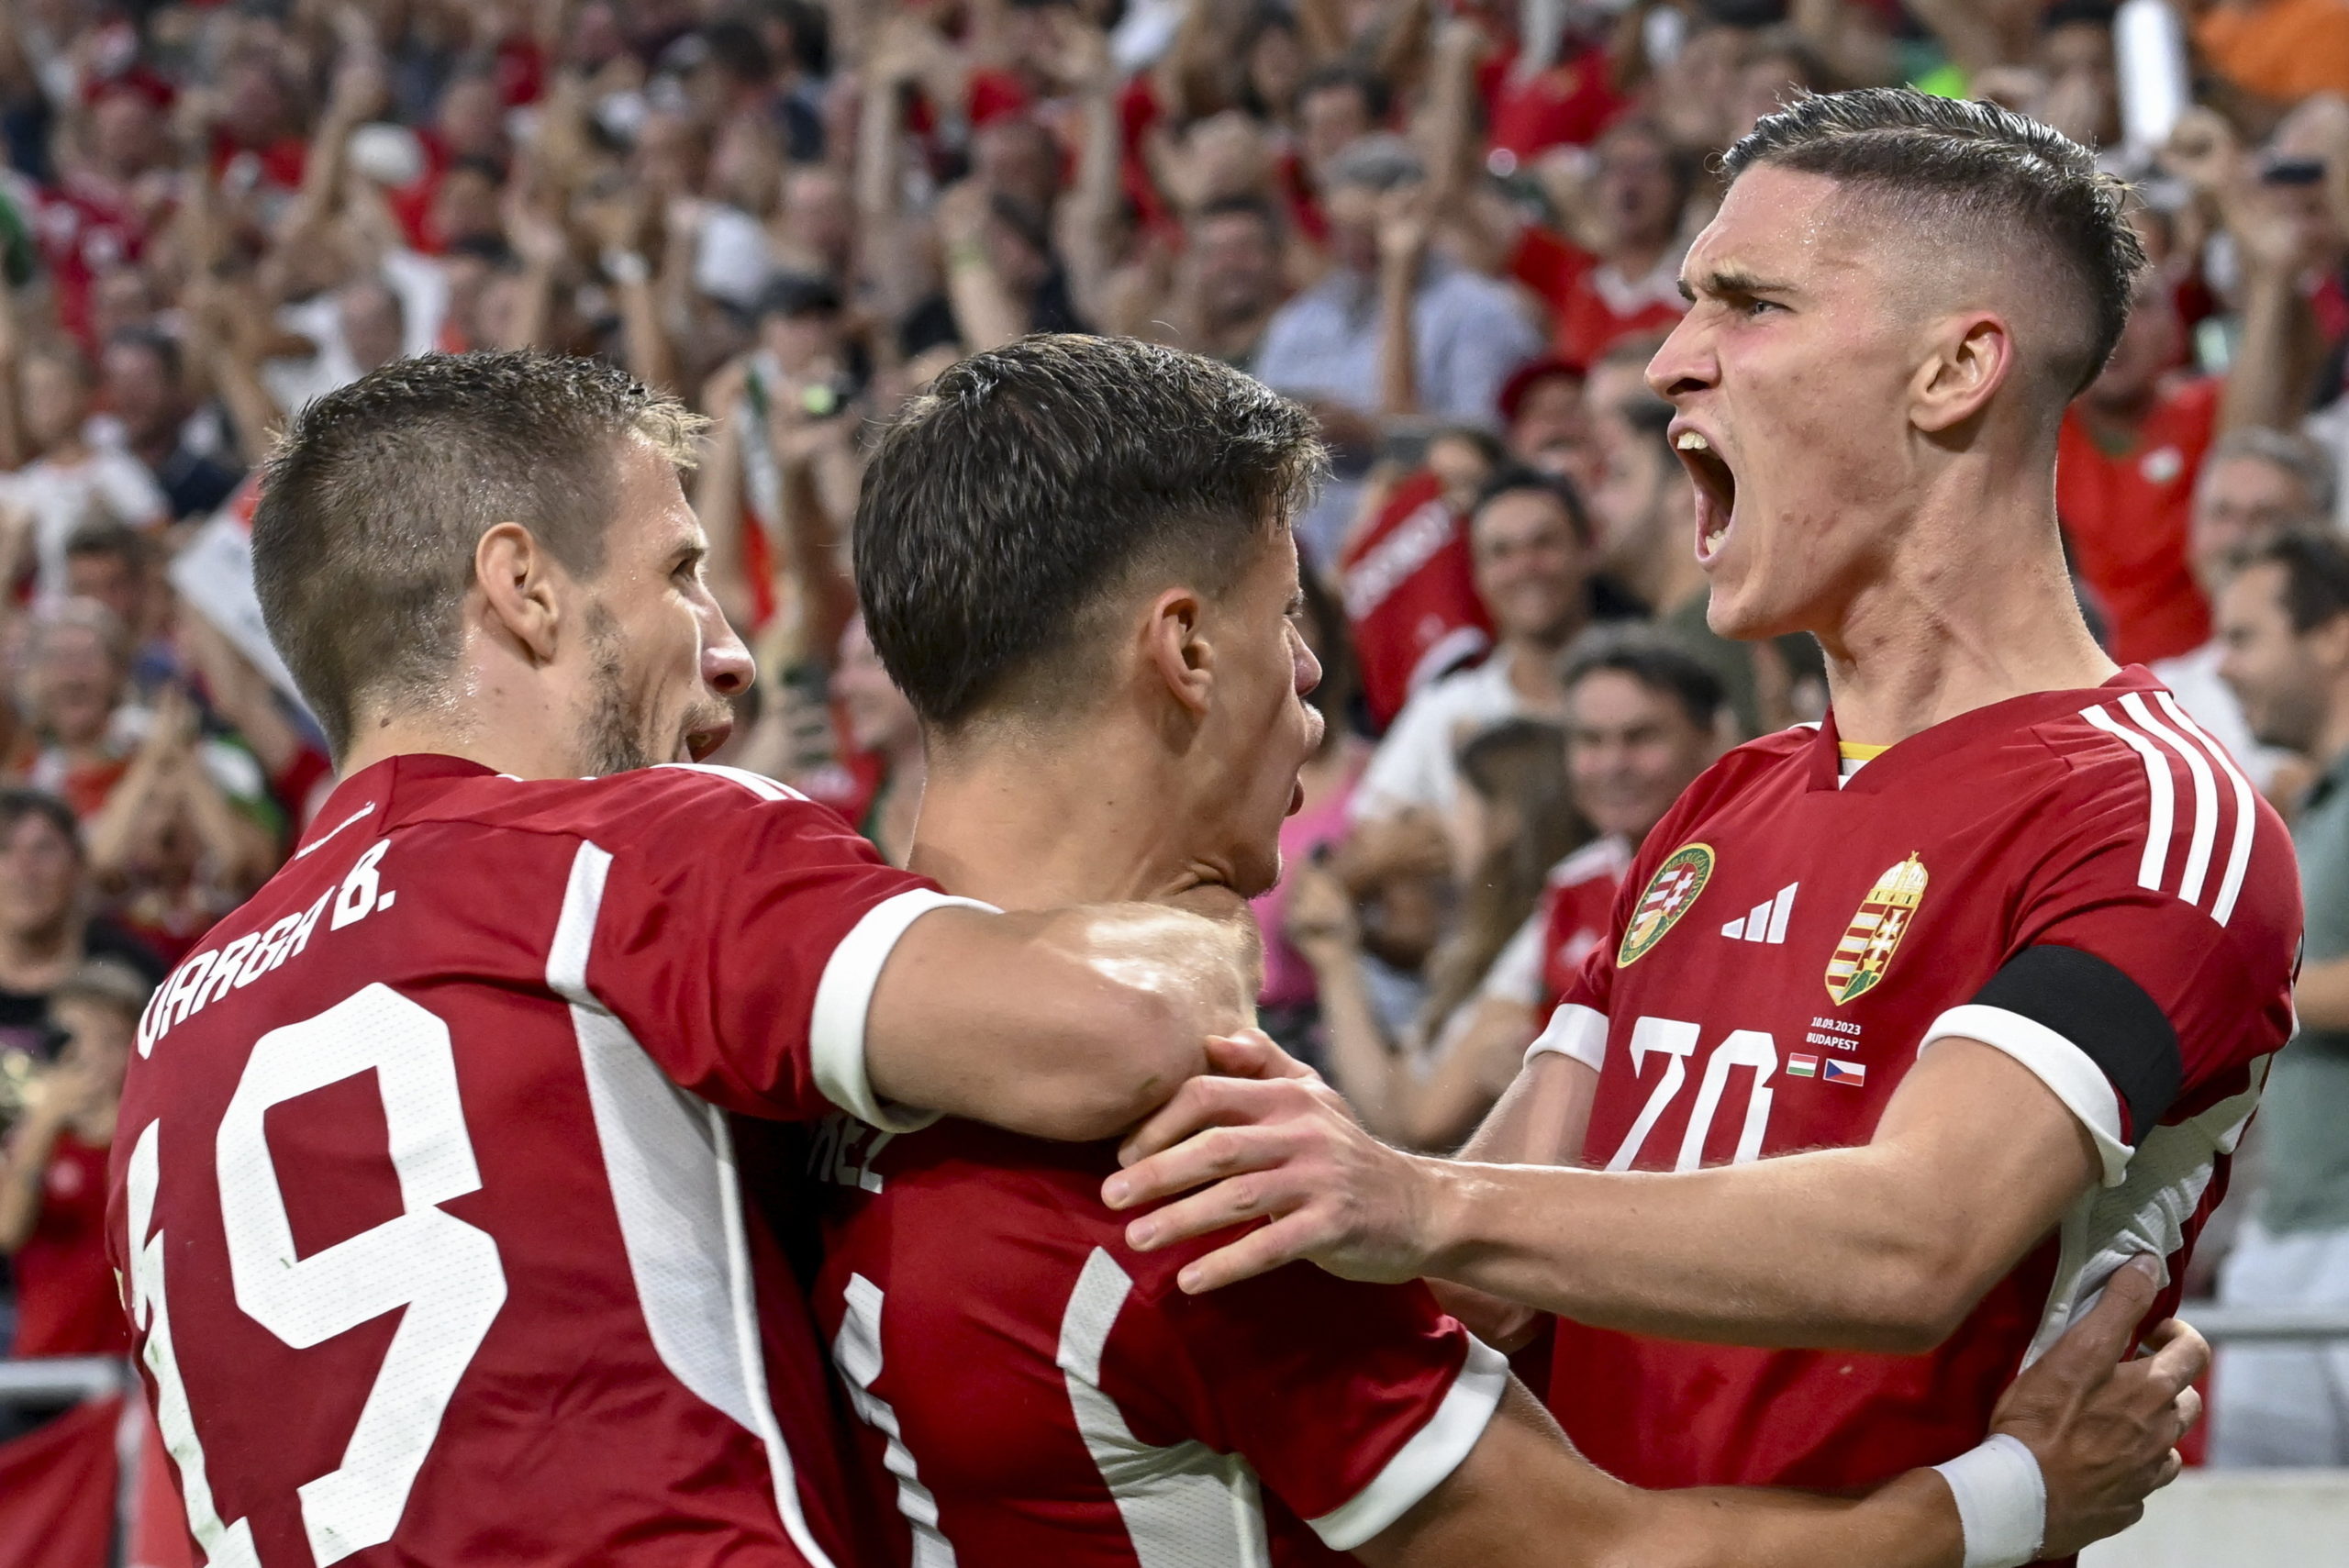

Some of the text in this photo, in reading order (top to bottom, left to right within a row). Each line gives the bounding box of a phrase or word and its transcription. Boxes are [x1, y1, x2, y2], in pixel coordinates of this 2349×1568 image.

[138, 838, 396, 1061] VARGA B.
[1806, 1032, 1860, 1051] BUDAPEST
[1810, 1016, 1862, 1036] 10.09.2023
[127, 982, 508, 1568] 19
